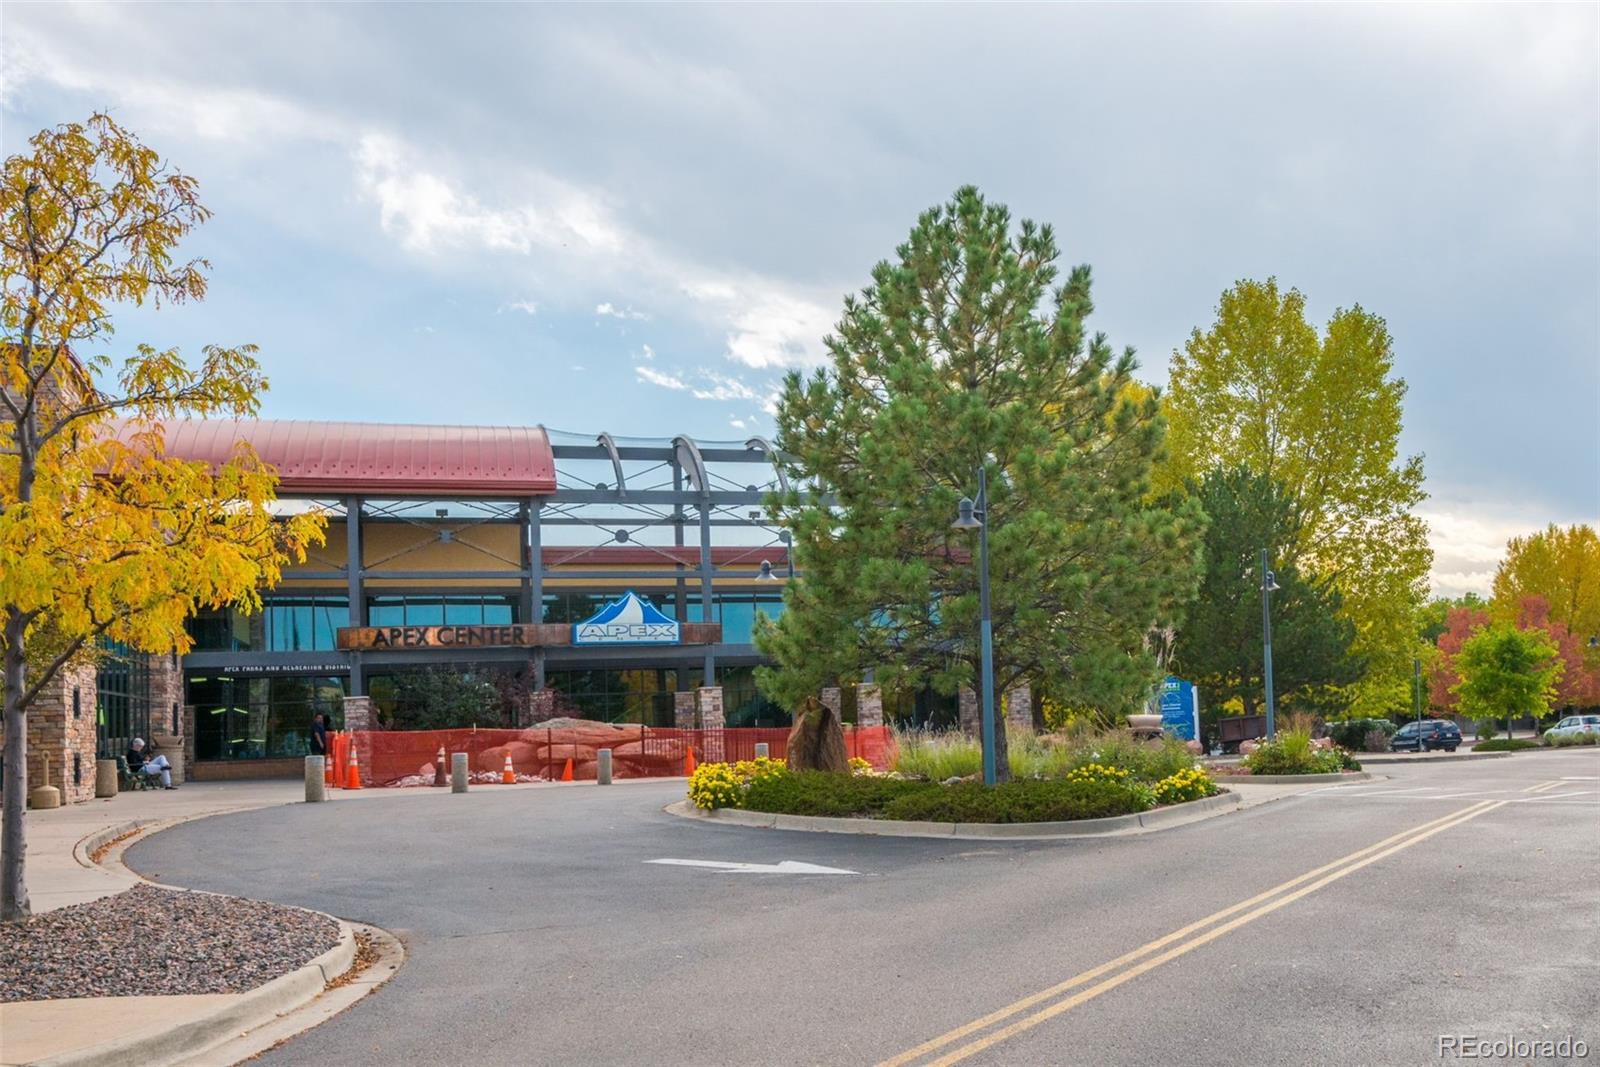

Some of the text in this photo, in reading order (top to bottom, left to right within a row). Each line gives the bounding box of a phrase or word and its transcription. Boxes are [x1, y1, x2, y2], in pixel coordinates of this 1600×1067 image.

[373, 627, 525, 647] APEX CENTER
[579, 625, 677, 637] APEX
